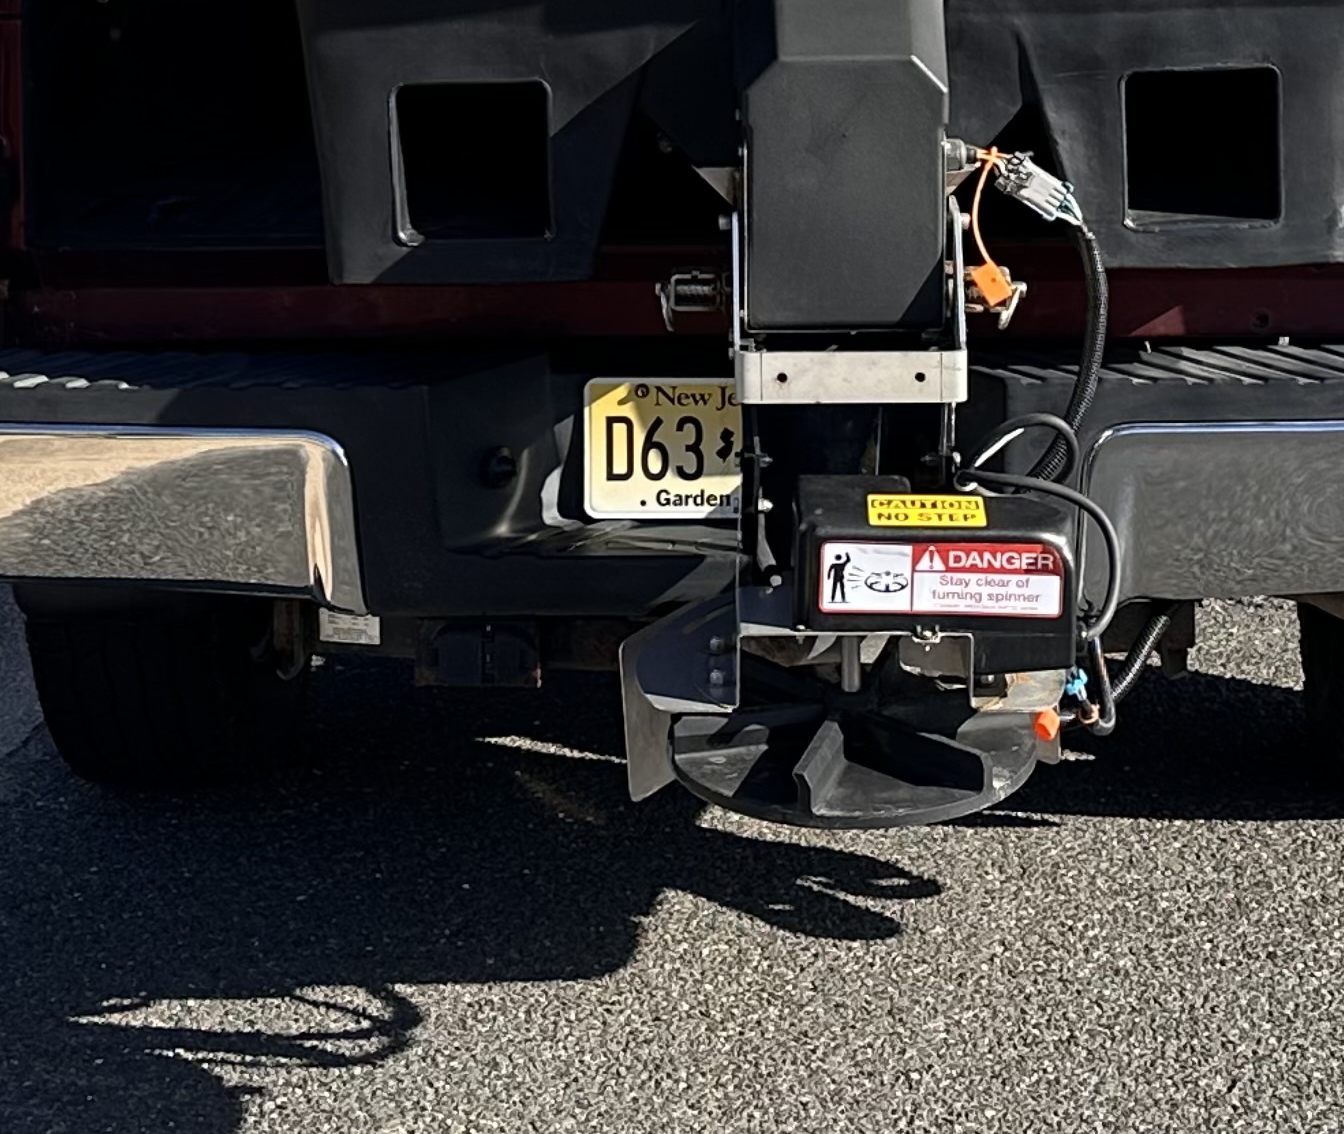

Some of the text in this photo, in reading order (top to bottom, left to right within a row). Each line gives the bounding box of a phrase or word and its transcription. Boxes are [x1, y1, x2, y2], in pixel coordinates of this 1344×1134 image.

[654, 385, 712, 407] New
[605, 415, 705, 482] D63
[655, 488, 732, 508] Garden
[872, 499, 979, 510] CAUTION
[877, 512, 977, 522] NO STEP
[948, 549, 1054, 570] DANGER
[939, 574, 1031, 589] Stay clear of
[931, 589, 1042, 604] turning spinner
